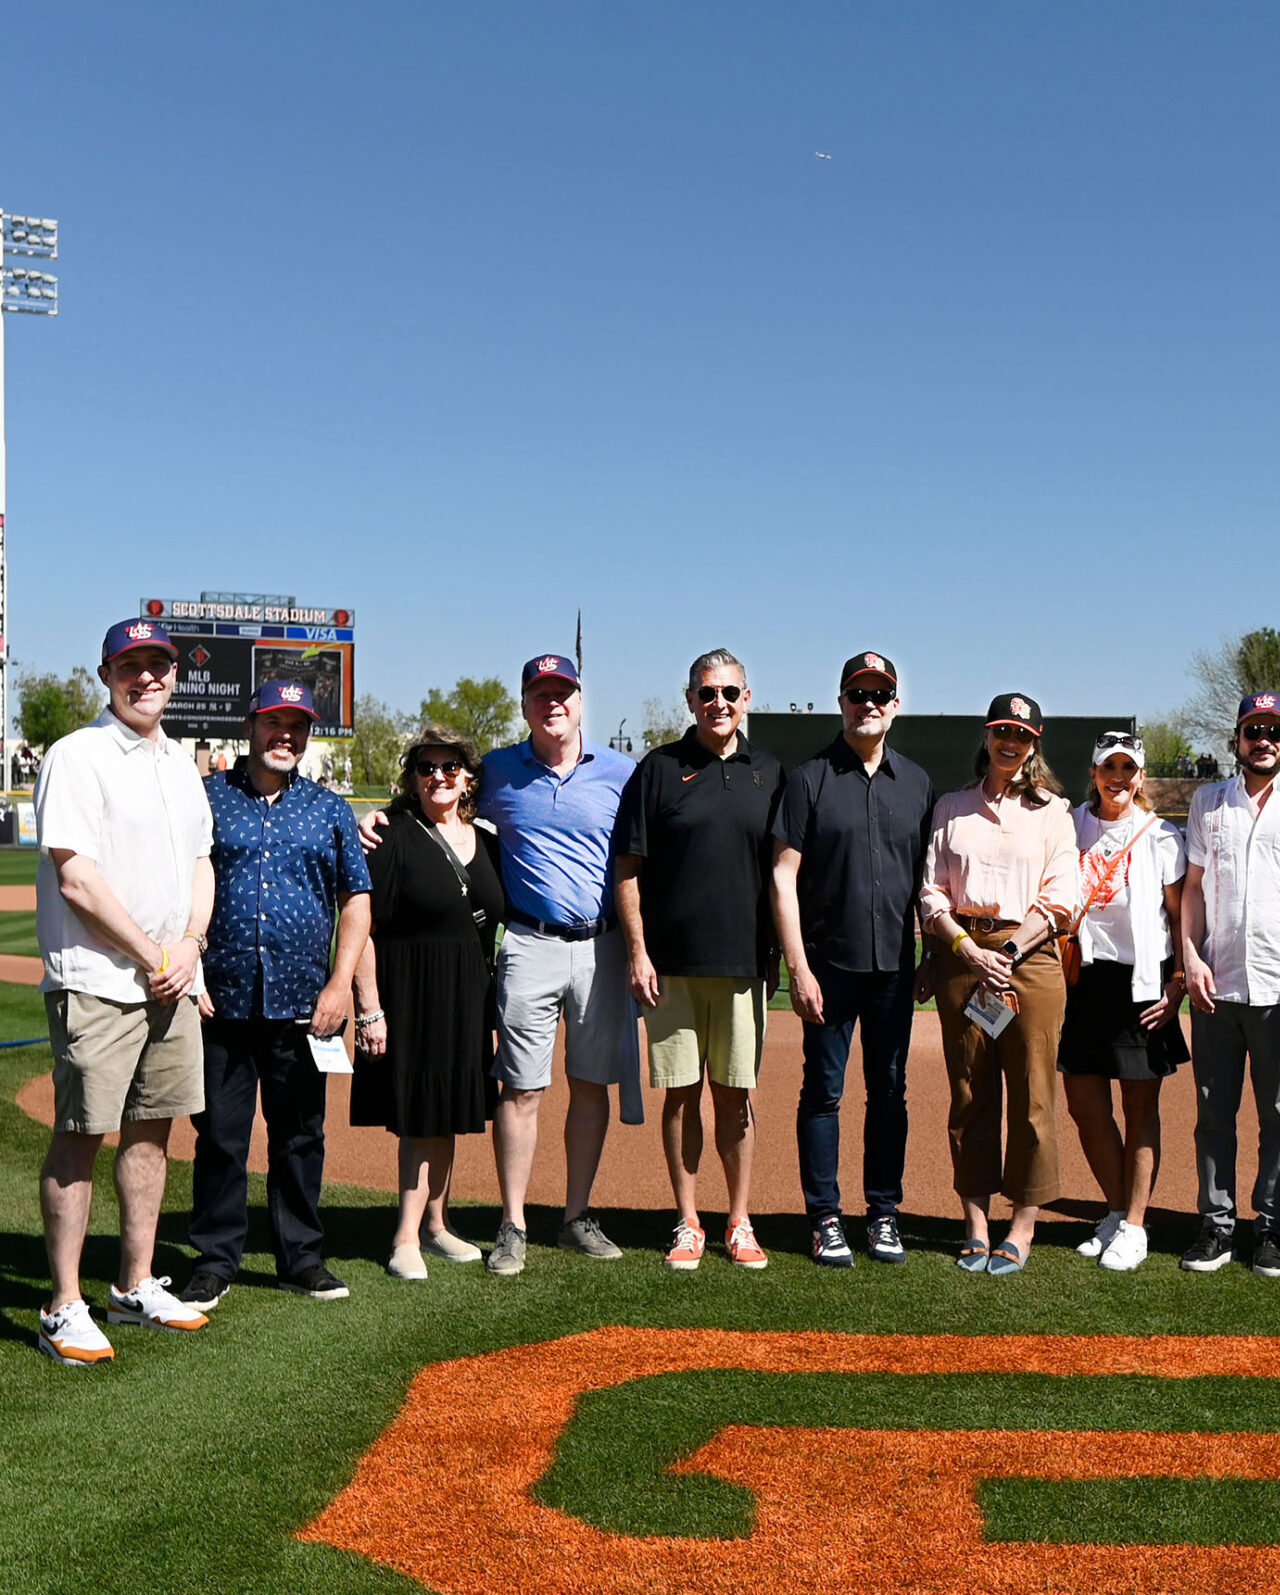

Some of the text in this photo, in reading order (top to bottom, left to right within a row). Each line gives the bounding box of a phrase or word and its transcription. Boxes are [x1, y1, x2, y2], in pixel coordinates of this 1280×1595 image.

[172, 602, 326, 622] SCOTTSDALE STADIUM
[304, 627, 338, 640] VISA
[188, 670, 210, 682] MLB
[172, 681, 240, 696] ENING NIGHT
[166, 702, 194, 710] MARCH
[338, 727, 353, 737] PM
